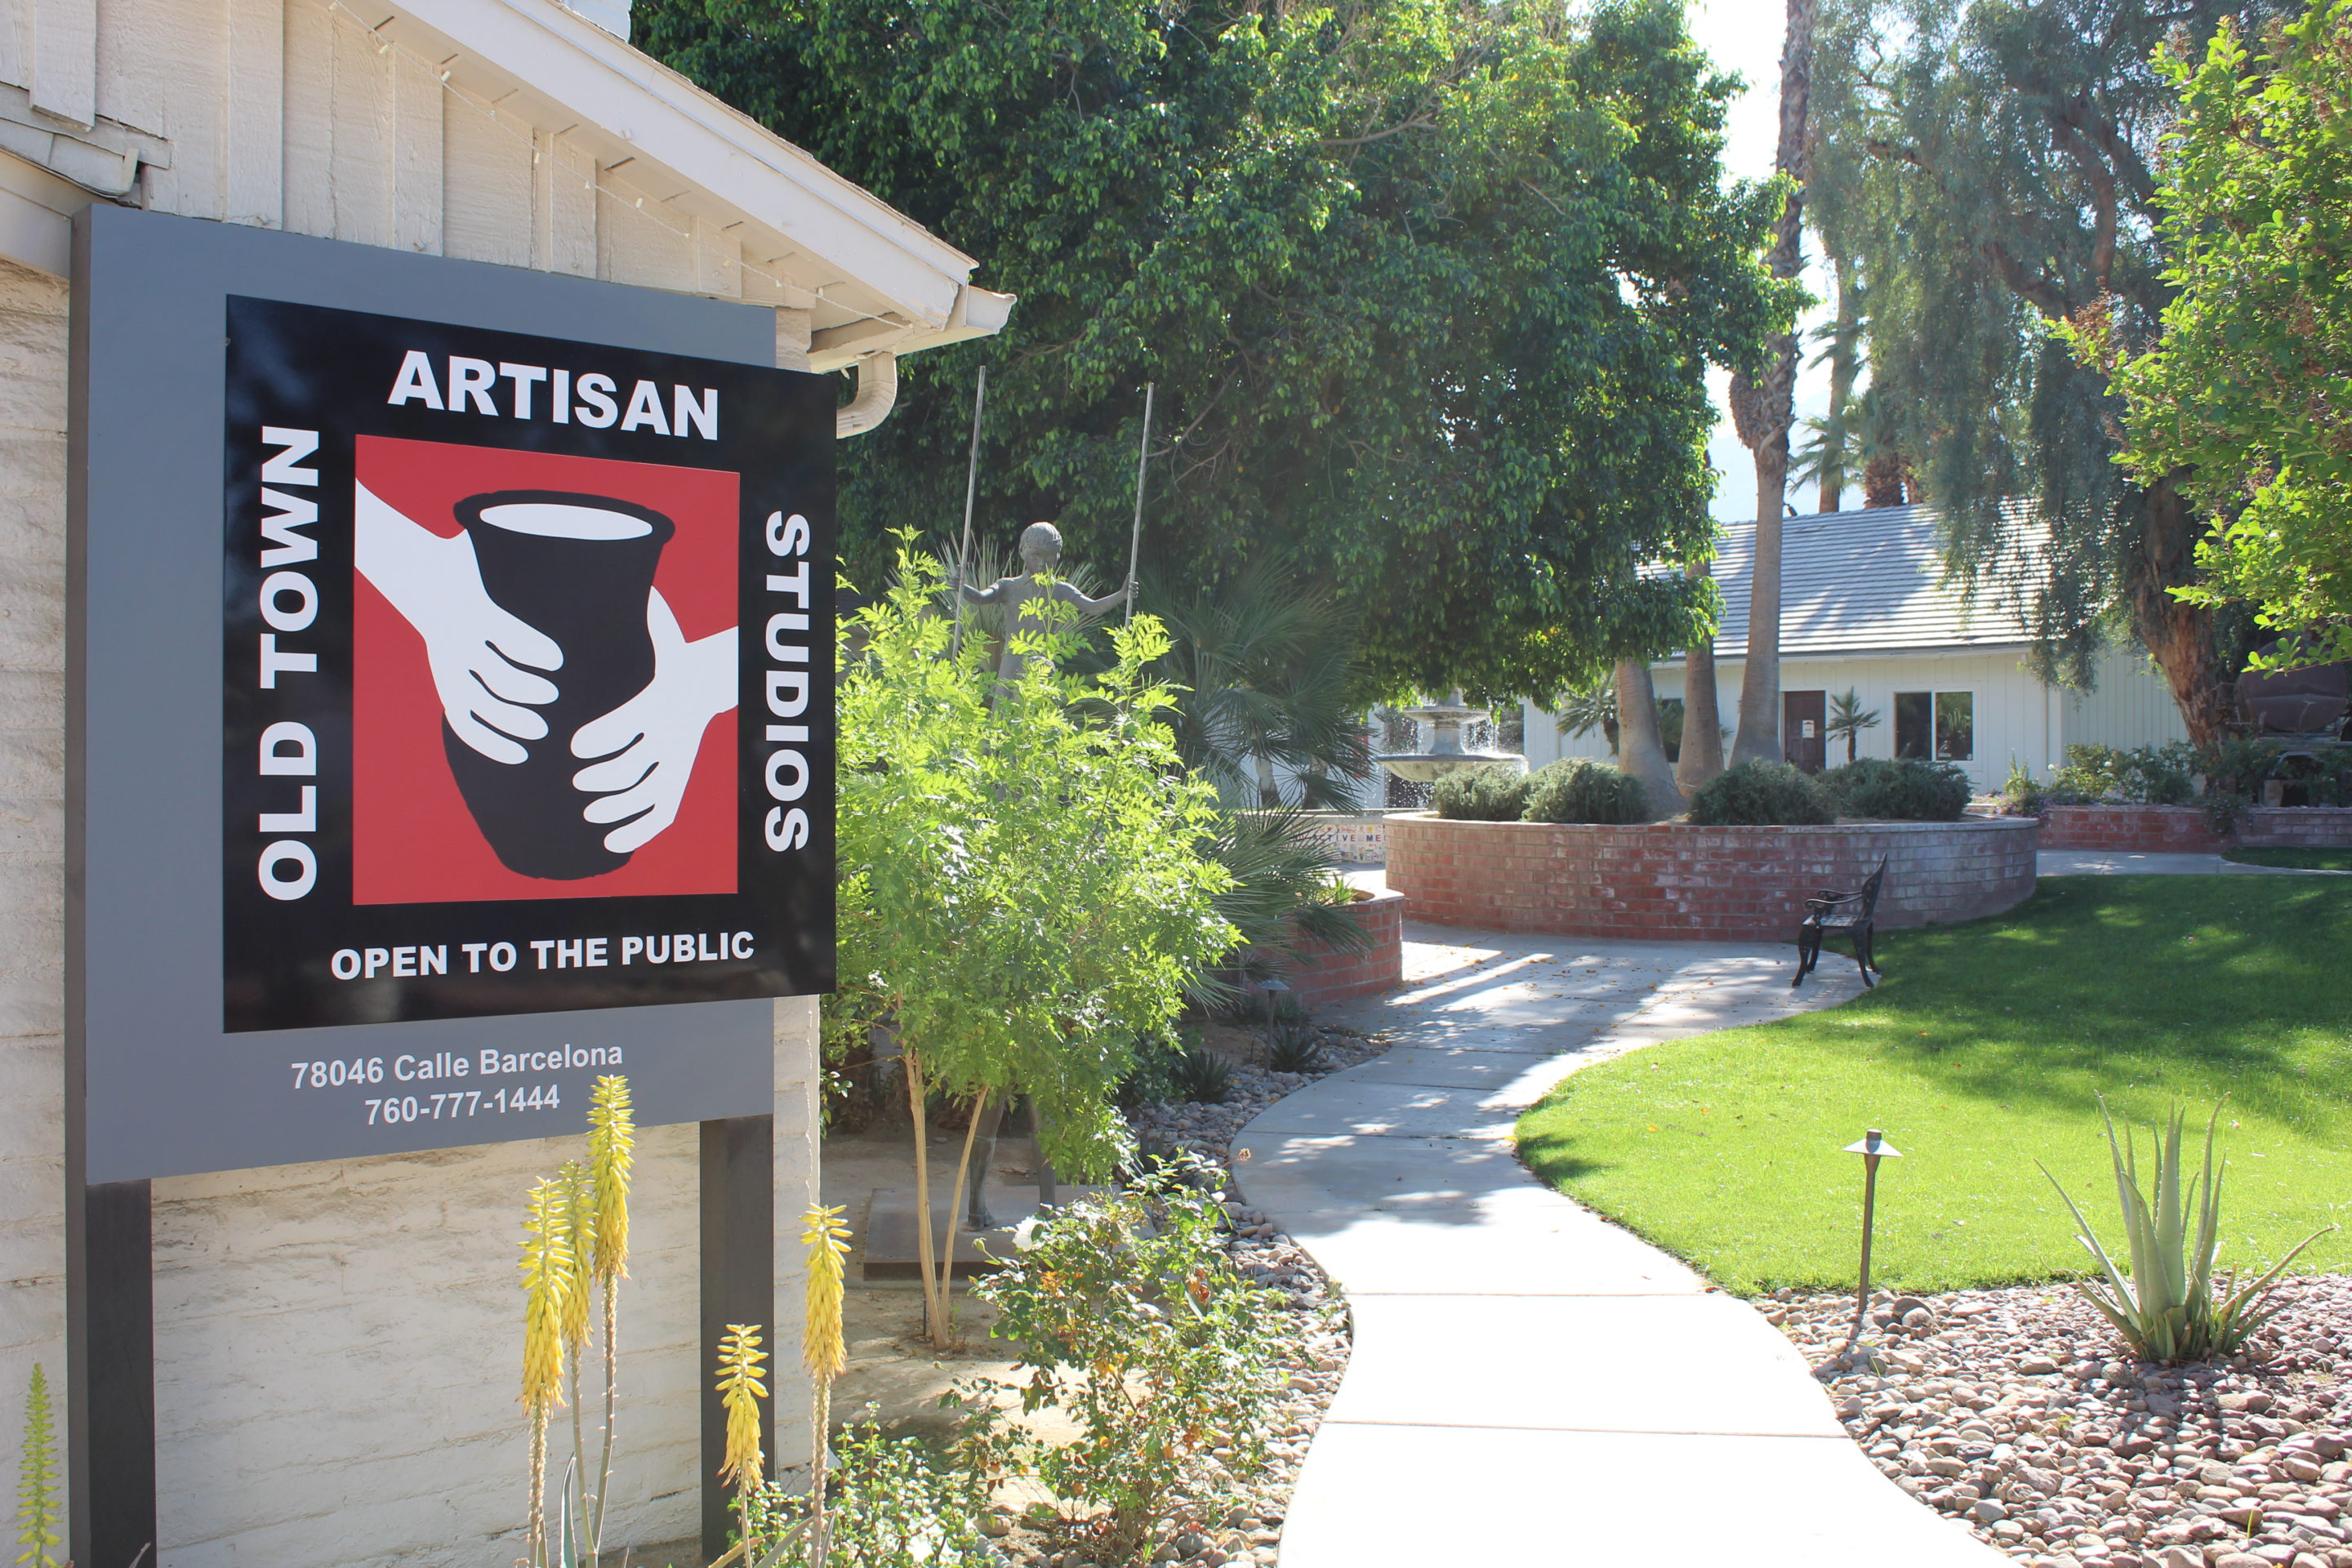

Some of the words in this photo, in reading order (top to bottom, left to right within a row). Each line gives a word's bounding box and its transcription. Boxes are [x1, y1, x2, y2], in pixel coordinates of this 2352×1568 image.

[386, 349, 719, 441] ARTISAN
[259, 425, 319, 690] TOWN
[764, 510, 811, 853] STUDIOS
[257, 720, 318, 902] OLD
[1366, 834, 1386, 842] ME
[331, 944, 448, 981] OPEN
[461, 941, 518, 974] TO
[529, 937, 608, 970] THE
[621, 930, 755, 966] PUBLIC
[290, 1056, 385, 1090] 78046
[394, 1051, 470, 1082] Calle
[479, 1042, 624, 1076] Barcelona
[363, 1083, 561, 1126] 760-777-1444
